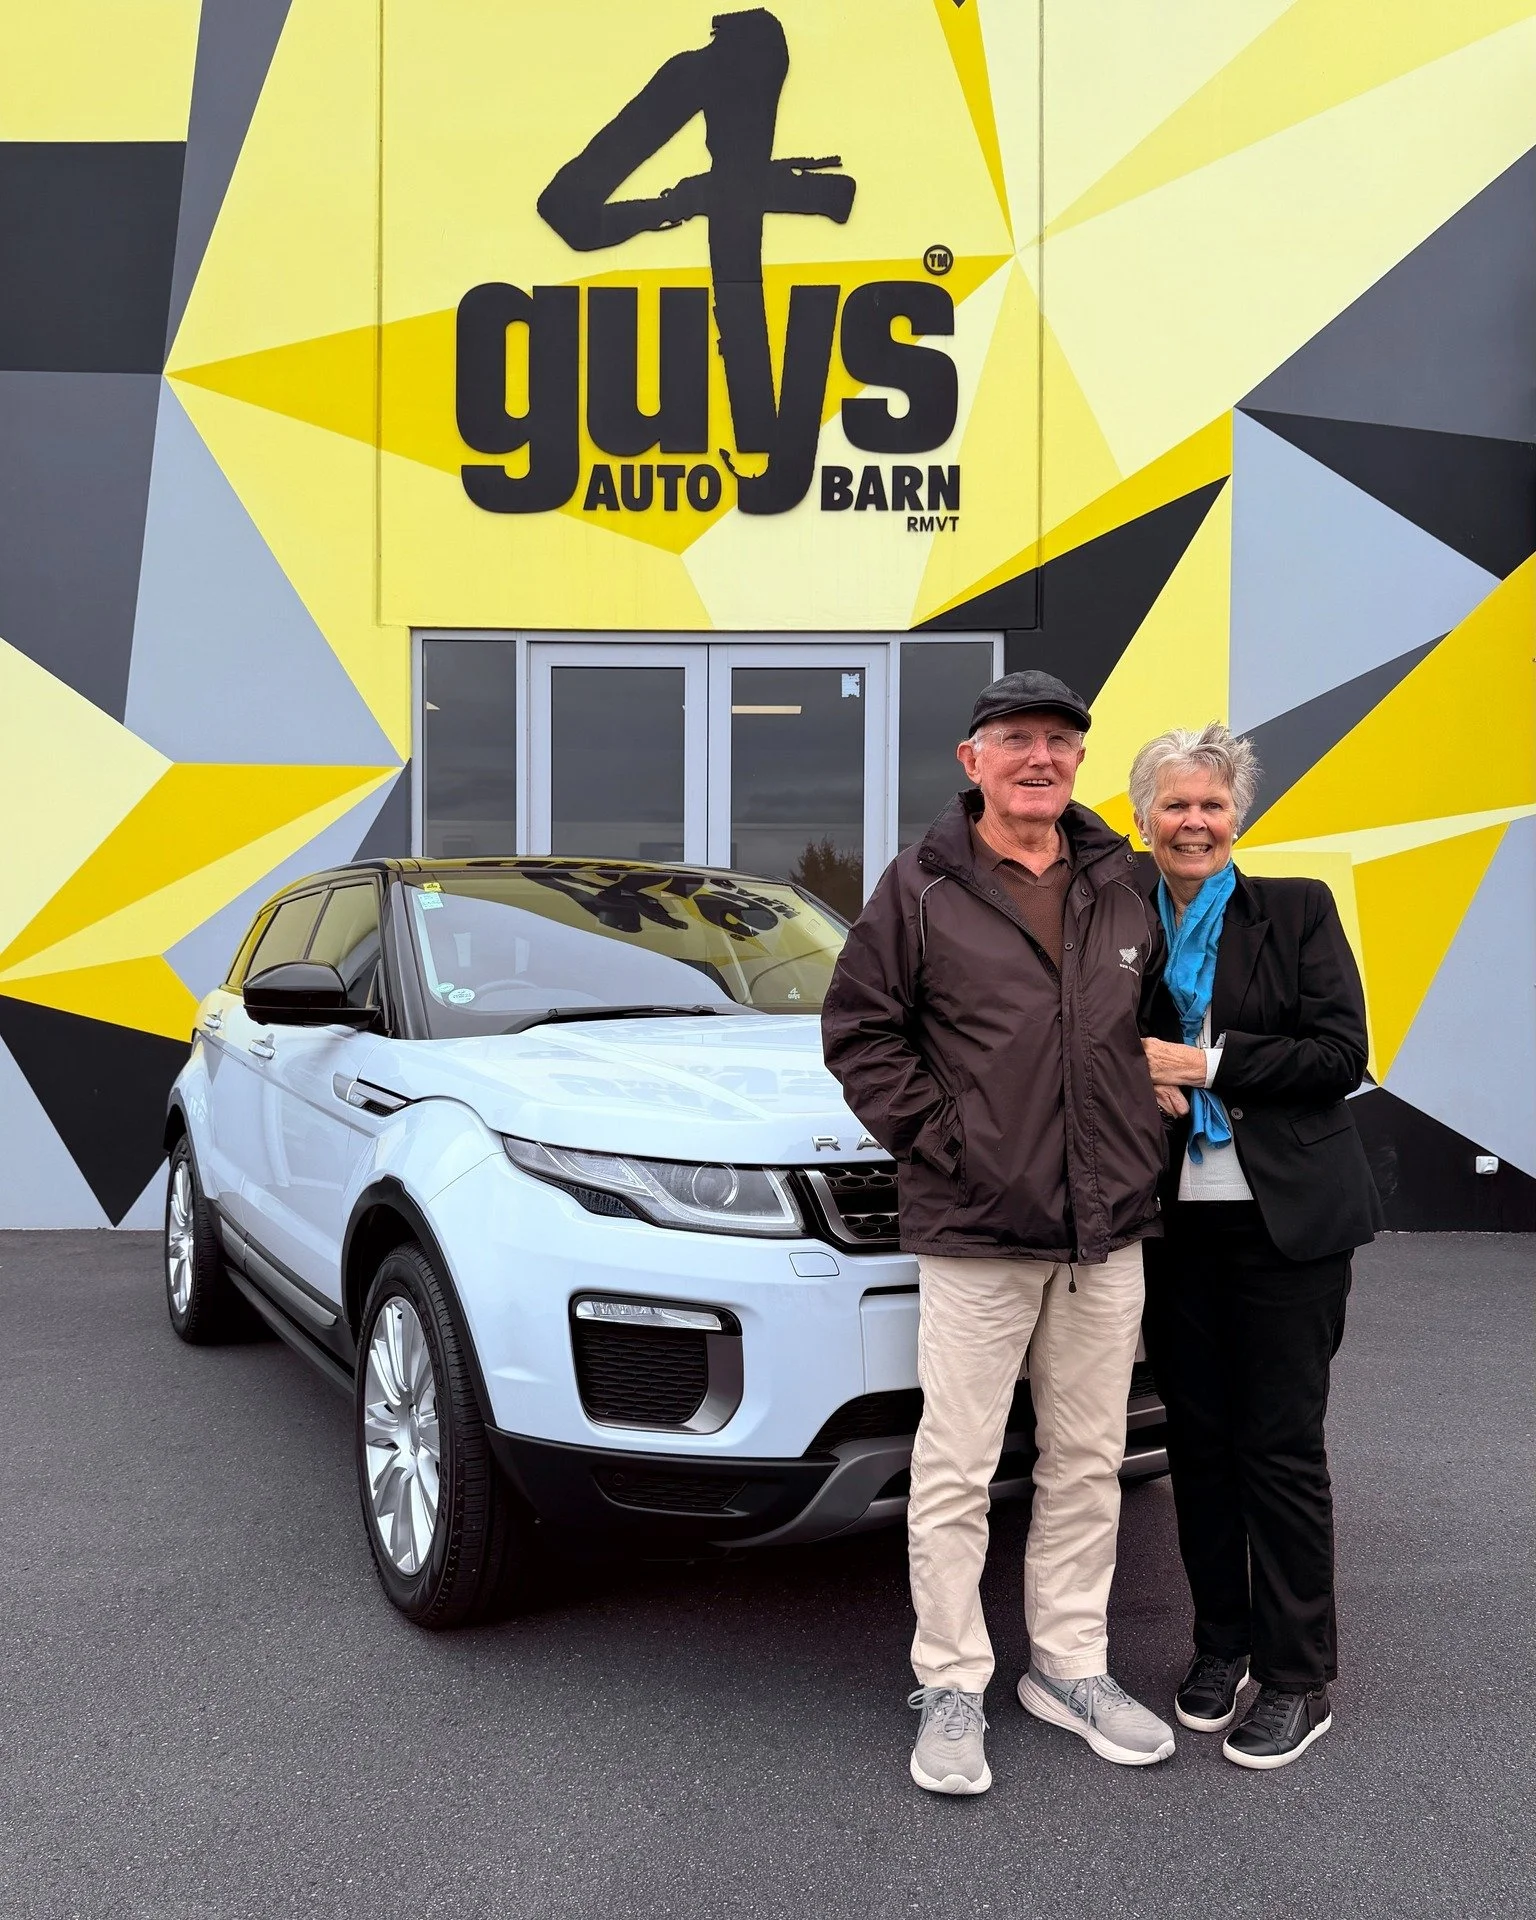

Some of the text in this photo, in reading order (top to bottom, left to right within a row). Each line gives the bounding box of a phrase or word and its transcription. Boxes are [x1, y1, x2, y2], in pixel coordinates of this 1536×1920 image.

[536, 8, 857, 282] 4
[456, 280, 959, 515] guys
[583, 464, 961, 512] AUTO BARN
[906, 515, 961, 533] RMVT
[811, 1134, 883, 1152] RA
